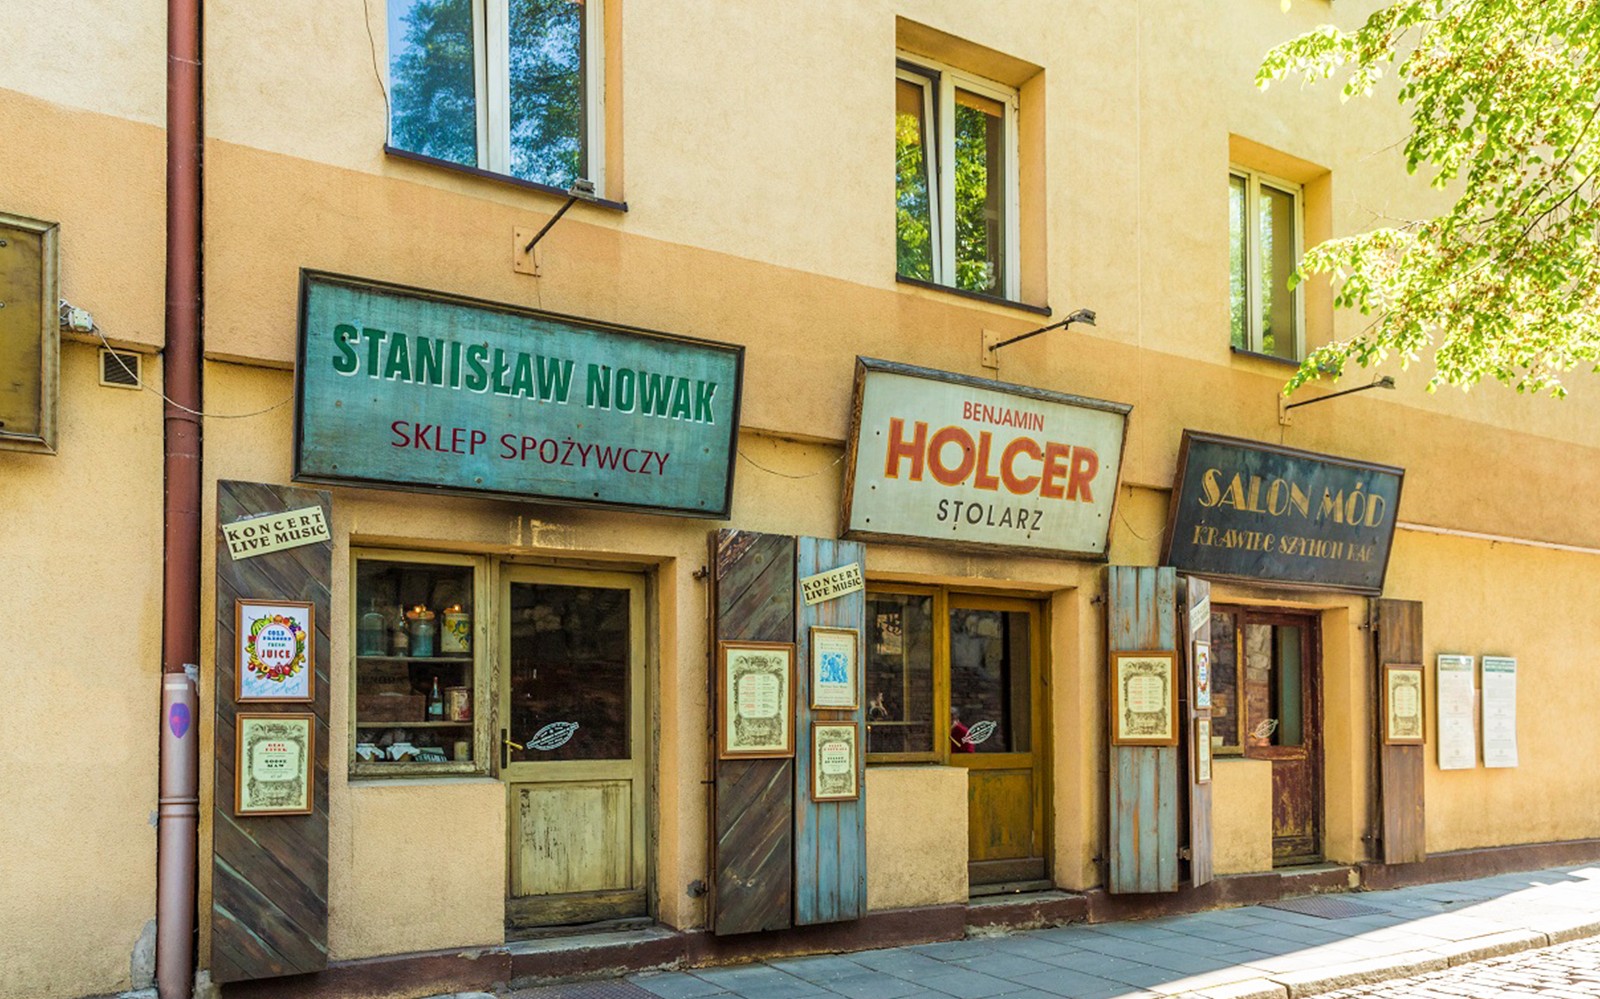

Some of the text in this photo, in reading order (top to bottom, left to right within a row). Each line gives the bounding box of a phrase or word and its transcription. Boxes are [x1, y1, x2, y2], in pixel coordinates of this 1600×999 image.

[332, 323, 718, 425] STANISŁAW NOWAK
[962, 401, 1045, 432] BENJAMIN
[391, 420, 670, 476] SKLEP SPOŻYWCZY
[884, 416, 1099, 504] HOLCER
[1198, 468, 1386, 528] SALON MÓD
[227, 513, 321, 541] KONCERT
[936, 499, 1043, 531] STOLARZ
[231, 524, 326, 553] LIVE MUSIC
[1192, 524, 1274, 552] KRAWIEC
[1278, 535, 1343, 559] SZYMON
[803, 568, 858, 592] KONCERT
[805, 577, 862, 601] LIVE MUSIC
[261, 649, 291, 659] JUICE
